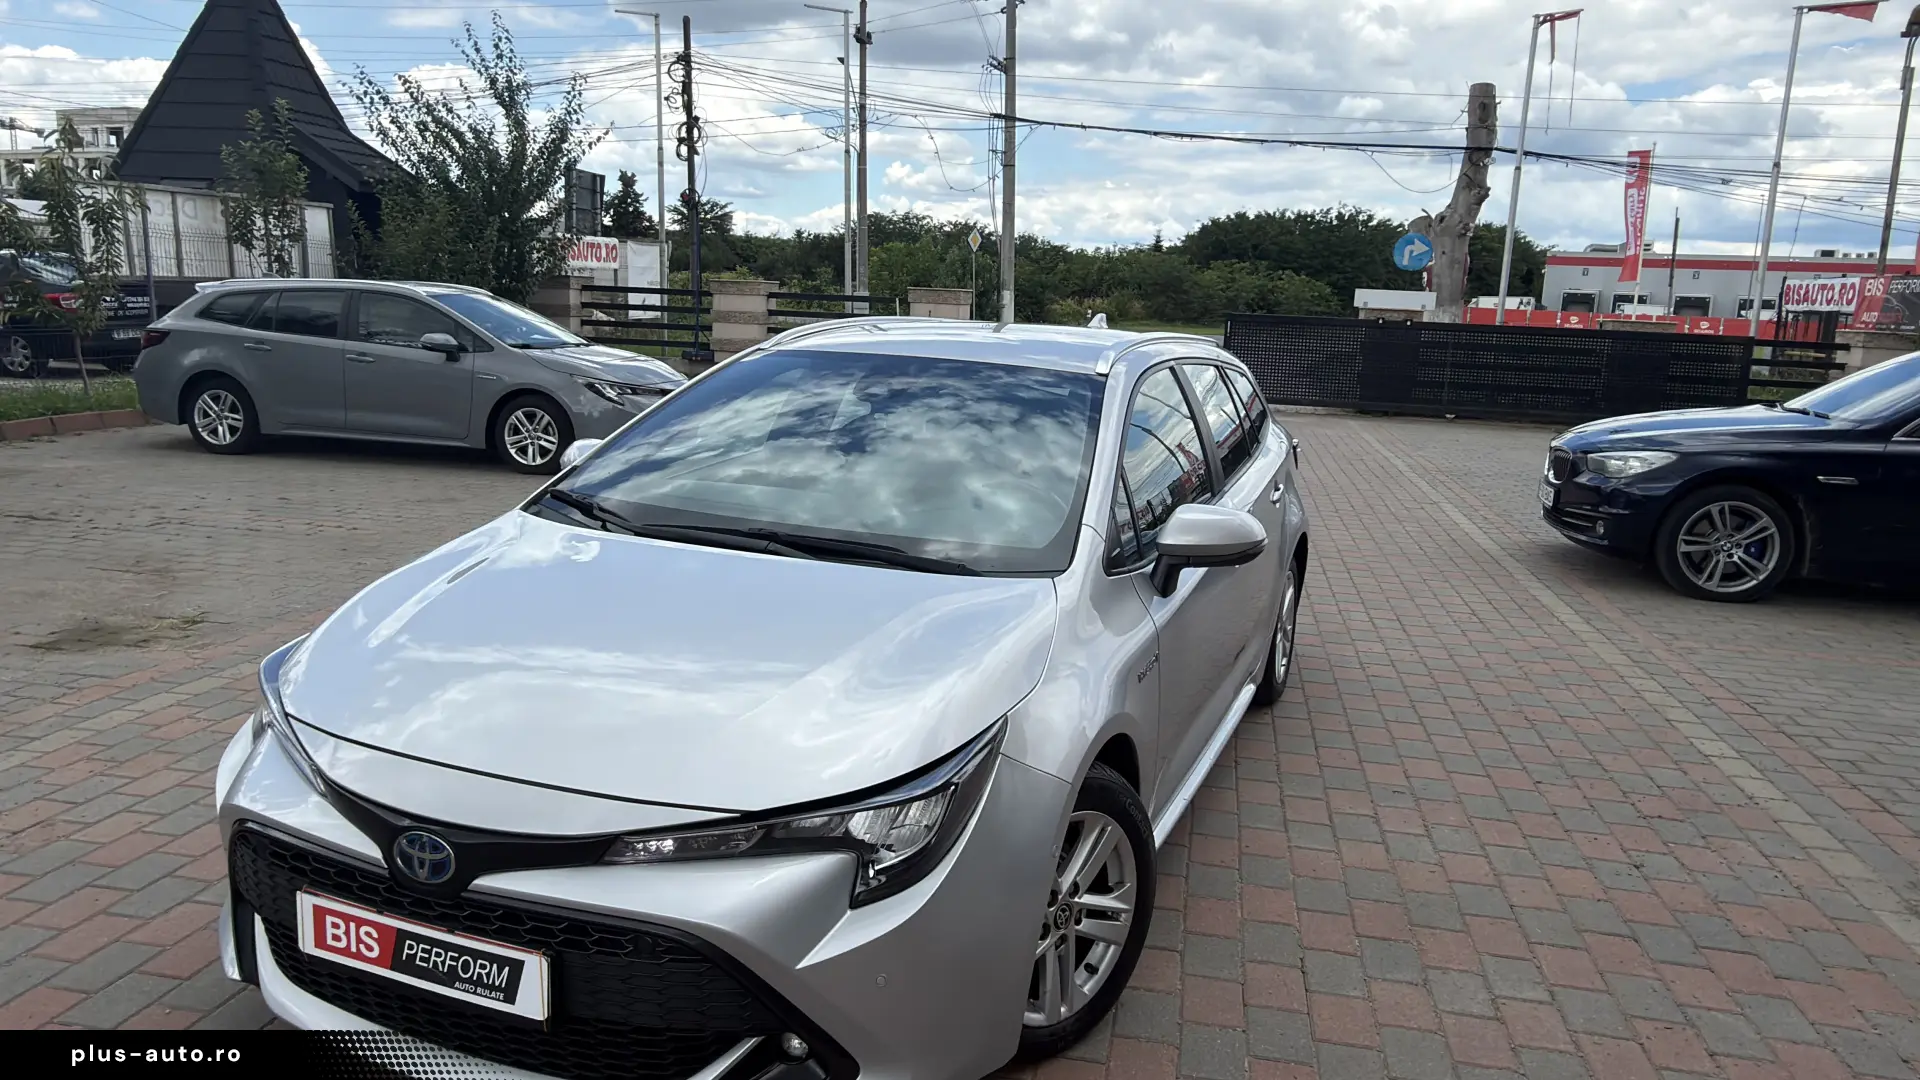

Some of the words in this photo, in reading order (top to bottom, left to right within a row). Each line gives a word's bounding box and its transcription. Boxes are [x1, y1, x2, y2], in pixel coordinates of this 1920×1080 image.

[1783, 282, 1857, 306] BISAUTO.RO
[1864, 278, 1885, 296] BIS
[325, 914, 380, 959] BIS
[402, 939, 510, 988] PERFORM
[453, 980, 476, 994] AUTO
[476, 986, 505, 1001] RULATE
